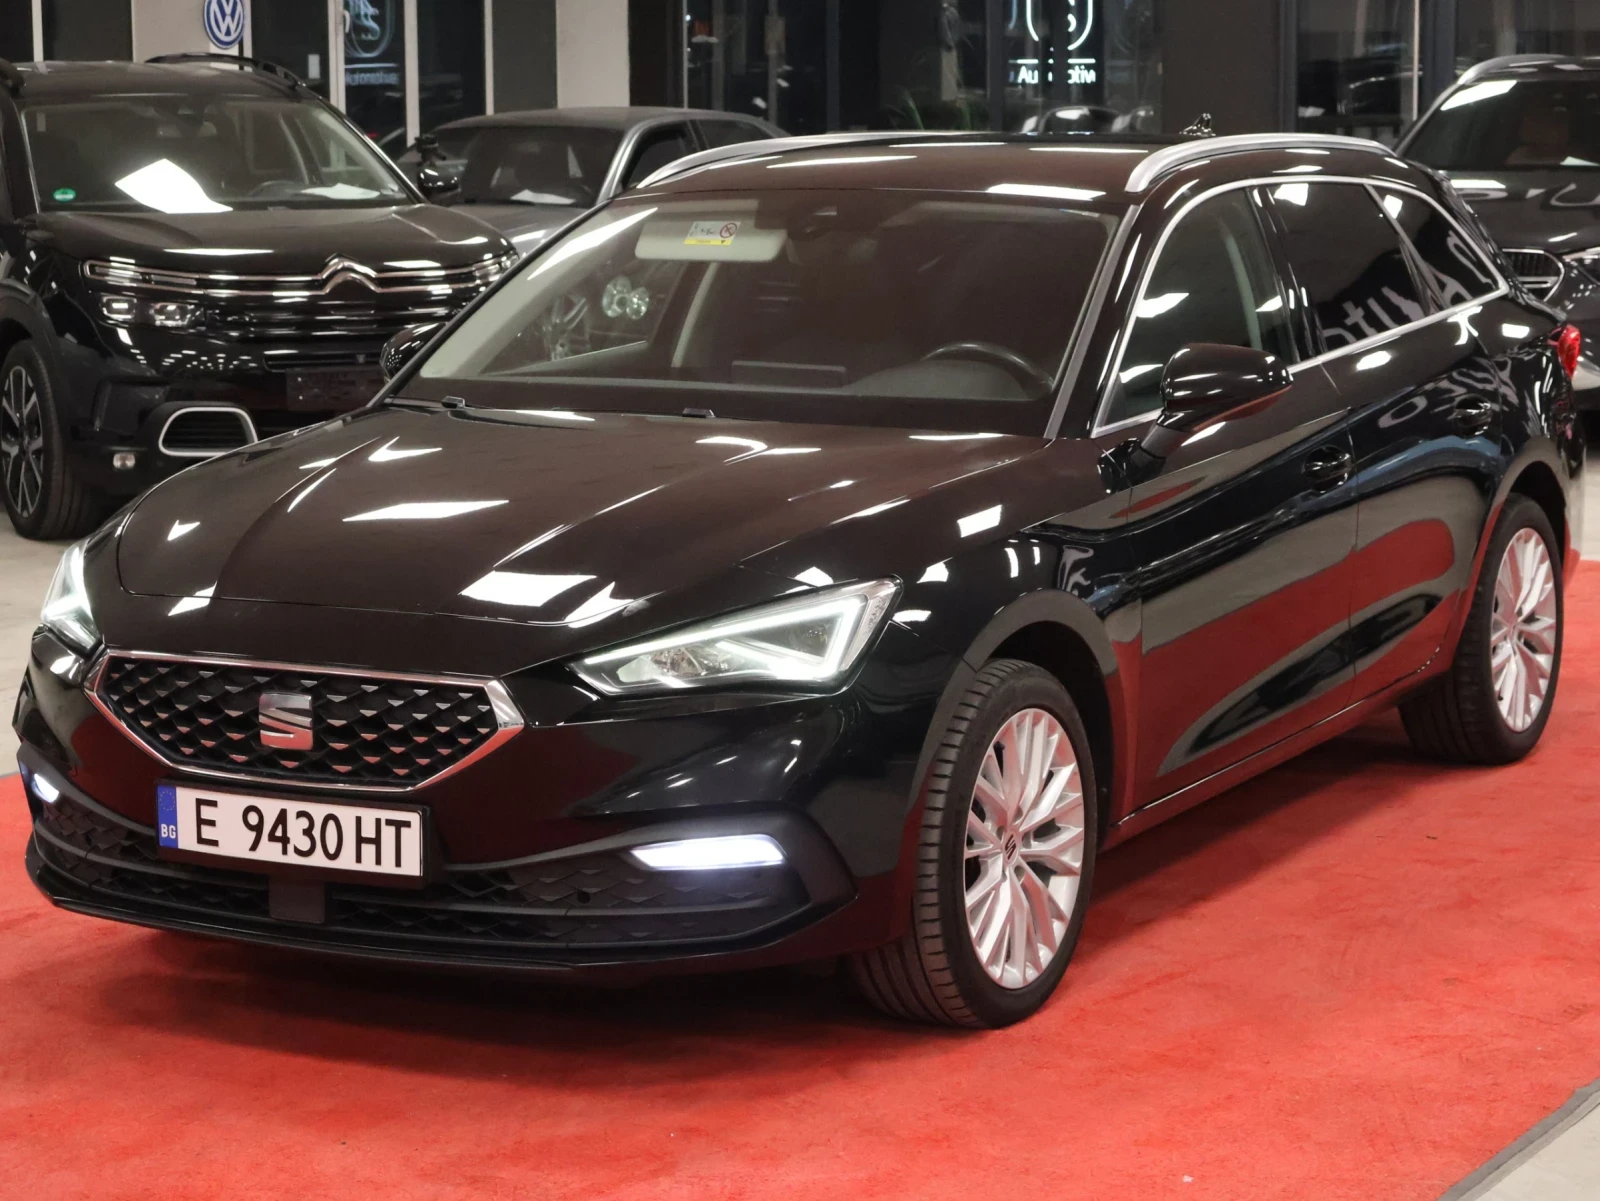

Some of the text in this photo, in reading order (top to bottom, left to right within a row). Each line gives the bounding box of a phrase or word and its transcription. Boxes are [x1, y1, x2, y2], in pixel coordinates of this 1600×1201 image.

[160, 823, 177, 839] BG
[195, 797, 412, 868] E 9430 HT
